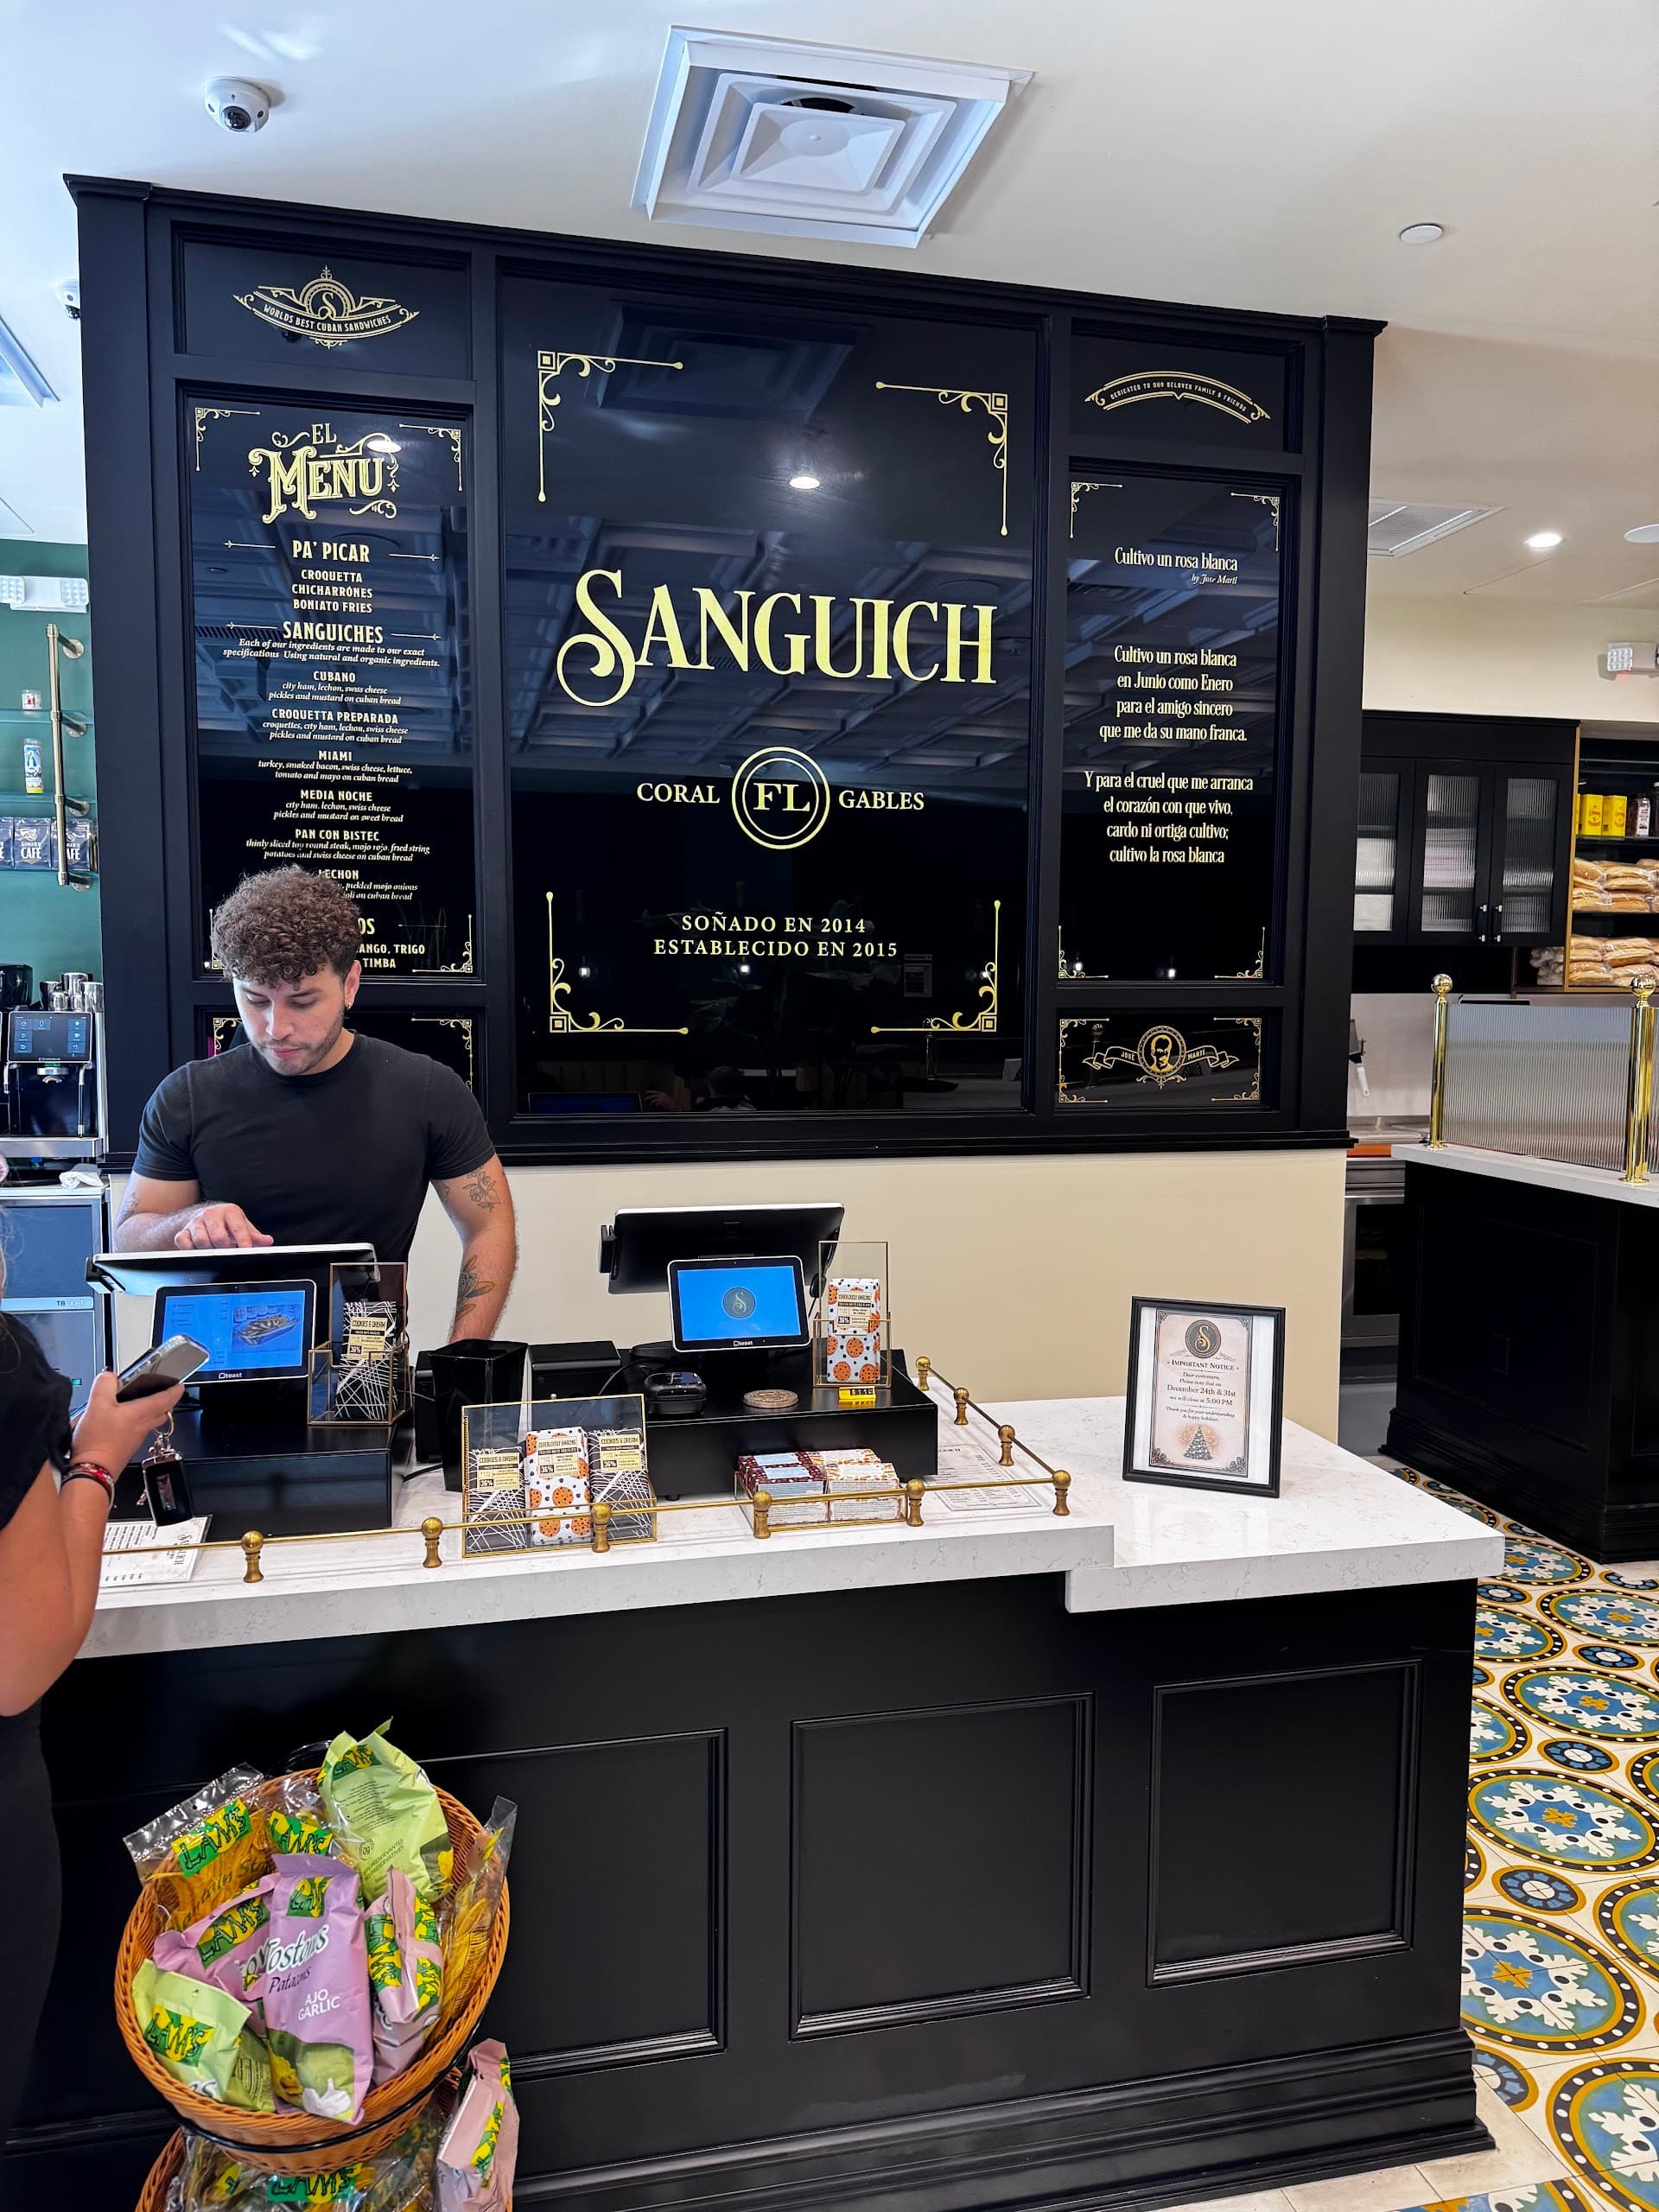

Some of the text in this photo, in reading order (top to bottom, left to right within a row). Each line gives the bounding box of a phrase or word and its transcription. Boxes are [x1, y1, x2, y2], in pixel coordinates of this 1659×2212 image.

[263, 303, 392, 333] WORLDS BEST CUBAN SANDWICHES
[1194, 385, 1216, 397] FAMILY
[1223, 394, 1247, 412] FRIENDS
[311, 423, 337, 444] EL
[248, 445, 385, 524] MENU
[292, 539, 371, 563] PA' PICAR
[1115, 546, 1238, 571] Cultivo un rosa blanca
[301, 569, 363, 583] CROQUETTA
[1191, 573, 1200, 585] by
[293, 599, 372, 614] BONIATO FRIES
[283, 620, 384, 645] SANGUICHES
[556, 569, 998, 707] SANGUICH
[238, 638, 260, 647] Each
[262, 639, 272, 649] of
[289, 641, 335, 652] ingredients
[222, 648, 440, 667] specifications Using natural and organic ingredients.
[1114, 645, 1237, 667] Cultivo un rosa blanca
[313, 671, 356, 683] CUBANO
[1116, 671, 1234, 692] en Junio como Enero
[268, 690, 295, 701] pickles
[295, 692, 310, 701] and
[311, 694, 344, 702] mustard
[355, 695, 378, 704] cuban
[379, 696, 402, 705] bread
[271, 708, 398, 724] CROQUETTA PREPARADA
[1116, 697, 1233, 719] para el amigo sincero
[1099, 722, 1248, 742] que me da su mano franca.
[318, 750, 353, 761] MIAMI
[257, 760, 285, 770] turkey,
[285, 760, 315, 770] smoked
[316, 761, 340, 771] bacon,
[361, 764, 386, 773] cheese,
[386, 765, 413, 774] lettuce,
[1084, 770, 1254, 794] Y para el cruel que me arranca
[300, 789, 372, 802] MEDIA NOCHE
[636, 781, 721, 804] CORAL
[753, 781, 810, 813] FL
[838, 789, 925, 811] GABLES
[1103, 796, 1233, 818] el corazón con que vivo,
[295, 829, 380, 842] PAN CON BISTEC
[1106, 821, 1229, 842] cardo ni ortiga cultivo;
[1109, 846, 1225, 863] cultivo la rosa blanca
[681, 911, 866, 933] SOÑADO EN 2014
[356, 944, 425, 955] ANGO, TRIGO
[653, 939, 898, 958] ESTABLECIDO EN 2015
[362, 958, 397, 969] TIMBA
[1172, 1359, 1209, 1368] IMPORTANT
[1166, 1384, 1199, 1393] December
[305, 1989, 328, 2006] AJO
[298, 1996, 341, 2021] GARLIC
